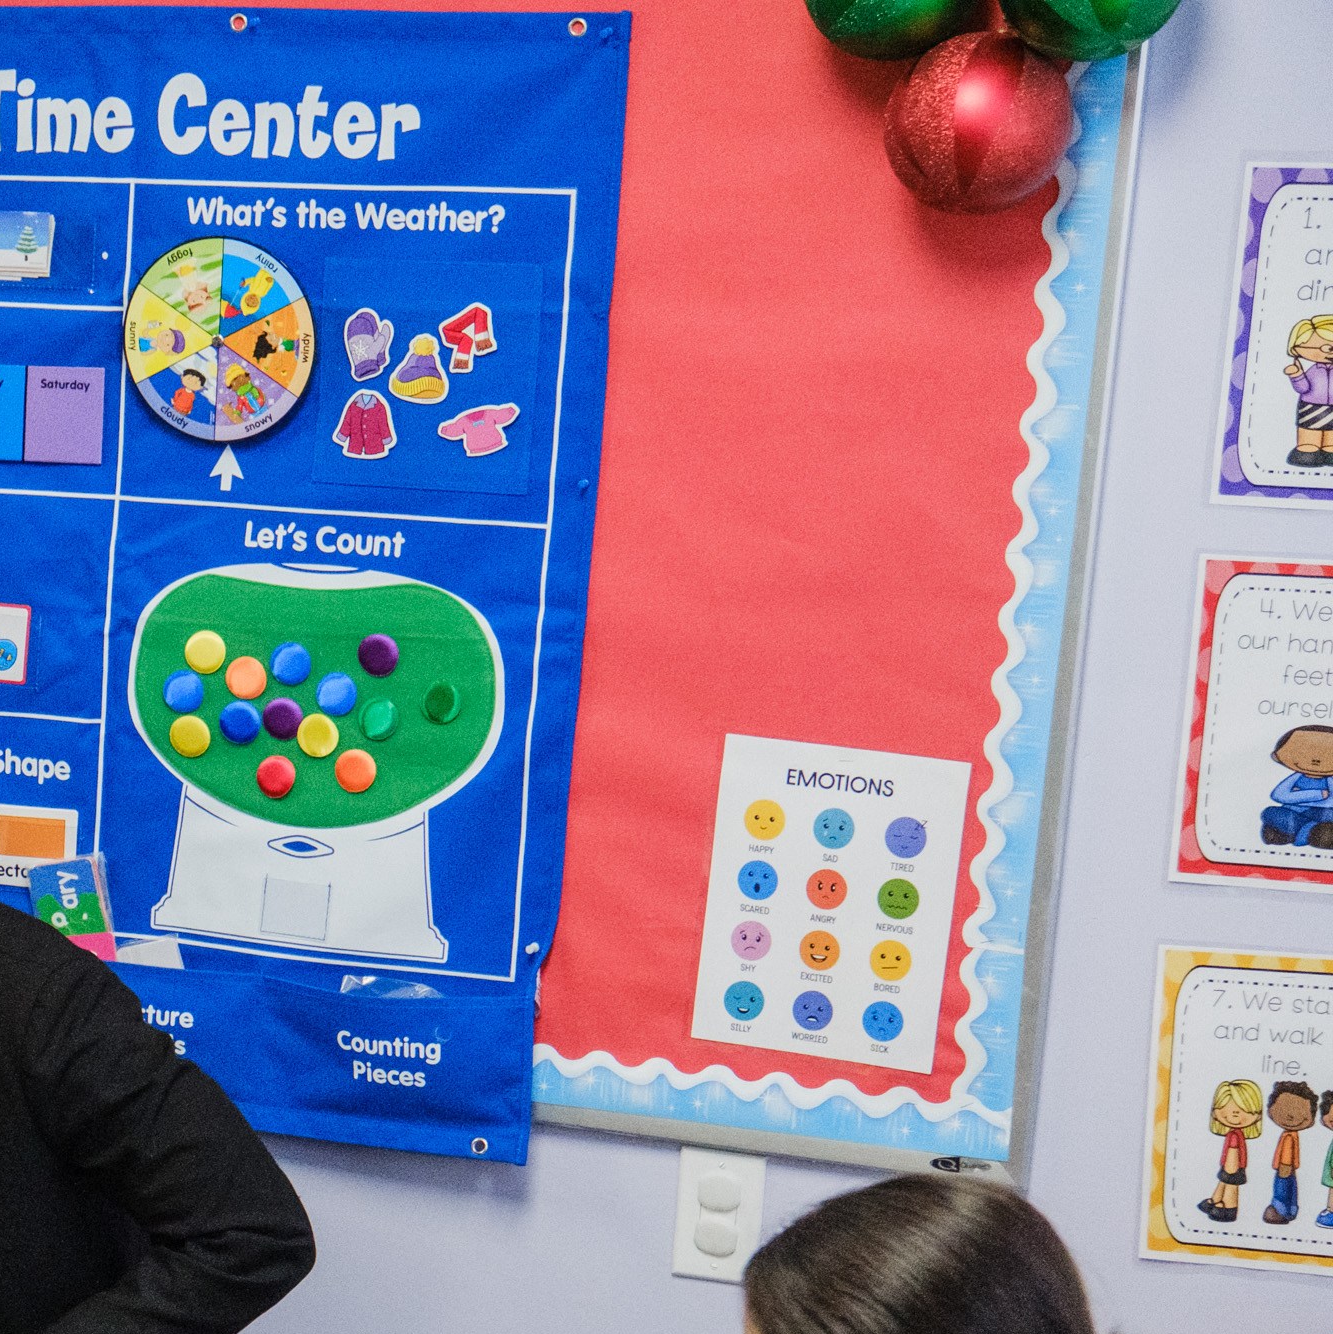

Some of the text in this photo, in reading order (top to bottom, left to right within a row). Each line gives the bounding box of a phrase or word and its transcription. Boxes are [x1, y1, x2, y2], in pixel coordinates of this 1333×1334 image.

[157, 72, 422, 161] Center
[187, 197, 506, 235] What's the Weather?
[1303, 206, 1322, 229] 1.
[166, 247, 194, 267] foggy
[255, 253, 279, 275] rainy
[127, 320, 137, 354] sunny
[300, 332, 313, 365] windy
[40, 378, 92, 394] Saturday
[160, 404, 190, 431] cloudy
[244, 413, 275, 434] snowy
[244, 520, 406, 559] Let's Count
[1259, 598, 1282, 620] 4.
[1237, 633, 1279, 651] our
[786, 768, 895, 799] EMOTIONS
[748, 844, 775, 855] HAPPY
[822, 853, 839, 863] SAD
[890, 862, 915, 874] TIRED
[739, 904, 770, 916] SCARED
[809, 914, 837, 925] ANGRY
[875, 923, 914, 935] NERVOUS
[739, 963, 757, 973] SHY
[799, 972, 833, 984] EXCITED
[873, 982, 901, 994] BORED
[1212, 989, 1233, 1009] 7.
[1242, 990, 1283, 1012] We
[730, 1022, 752, 1033] SILLY
[791, 1031, 829, 1044] WORRIED
[1213, 1022, 1324, 1046] and walk
[336, 1030, 441, 1064] Counting
[869, 1044, 890, 1054] SICK
[352, 1061, 427, 1088] Pieces
[1261, 1055, 1309, 1077] line.
